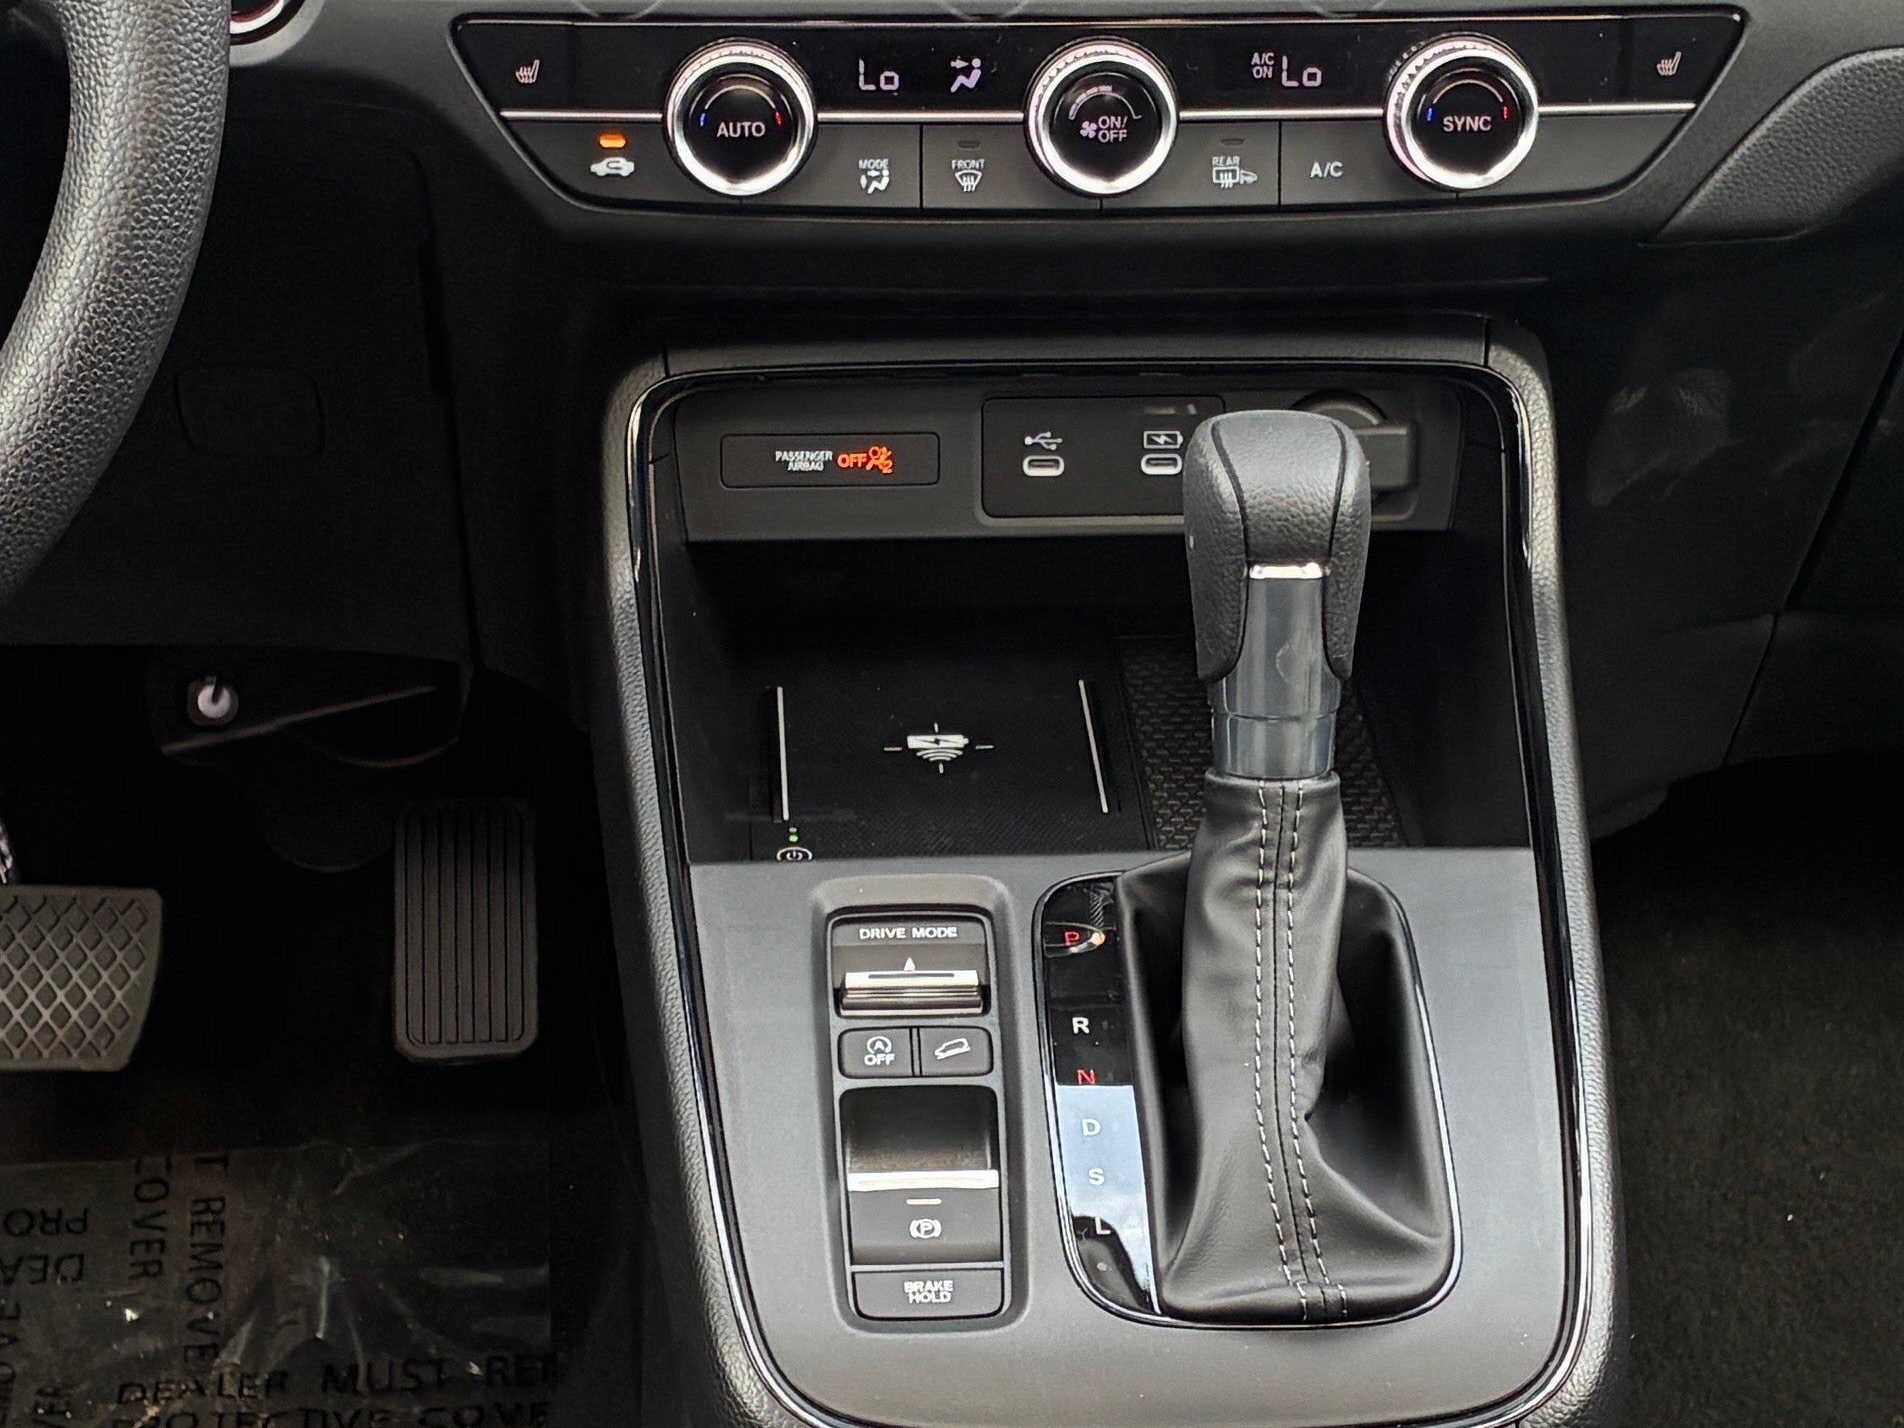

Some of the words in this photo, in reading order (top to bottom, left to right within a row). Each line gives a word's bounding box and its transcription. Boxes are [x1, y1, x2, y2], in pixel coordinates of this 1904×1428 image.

[1250, 51, 1276, 66] A/C
[1252, 66, 1273, 80] ON
[716, 121, 766, 138] AUTO
[1098, 114, 1128, 130] ON/
[1442, 114, 1492, 132] SYNC
[1098, 129, 1128, 144] OFF
[858, 158, 890, 170] MODE
[951, 158, 986, 171] FRONT
[1211, 155, 1241, 166] REAR
[1309, 161, 1344, 178] A/C
[775, 449, 834, 463] PASSENGER
[836, 452, 868, 469] OFF
[786, 460, 825, 472] AIRBAG
[859, 926, 907, 941] DRIVE
[911, 925, 959, 939] MODE
[1064, 931, 1081, 947] P
[1071, 1016, 1091, 1035] R
[863, 1053, 895, 1066] OFF
[1077, 1068, 1098, 1085] N
[1081, 1118, 1102, 1137] D
[1087, 1167, 1106, 1186] S
[1094, 1216, 1112, 1236] L
[903, 1279, 954, 1293] BRAKE
[907, 1290, 953, 1304] HOLD
